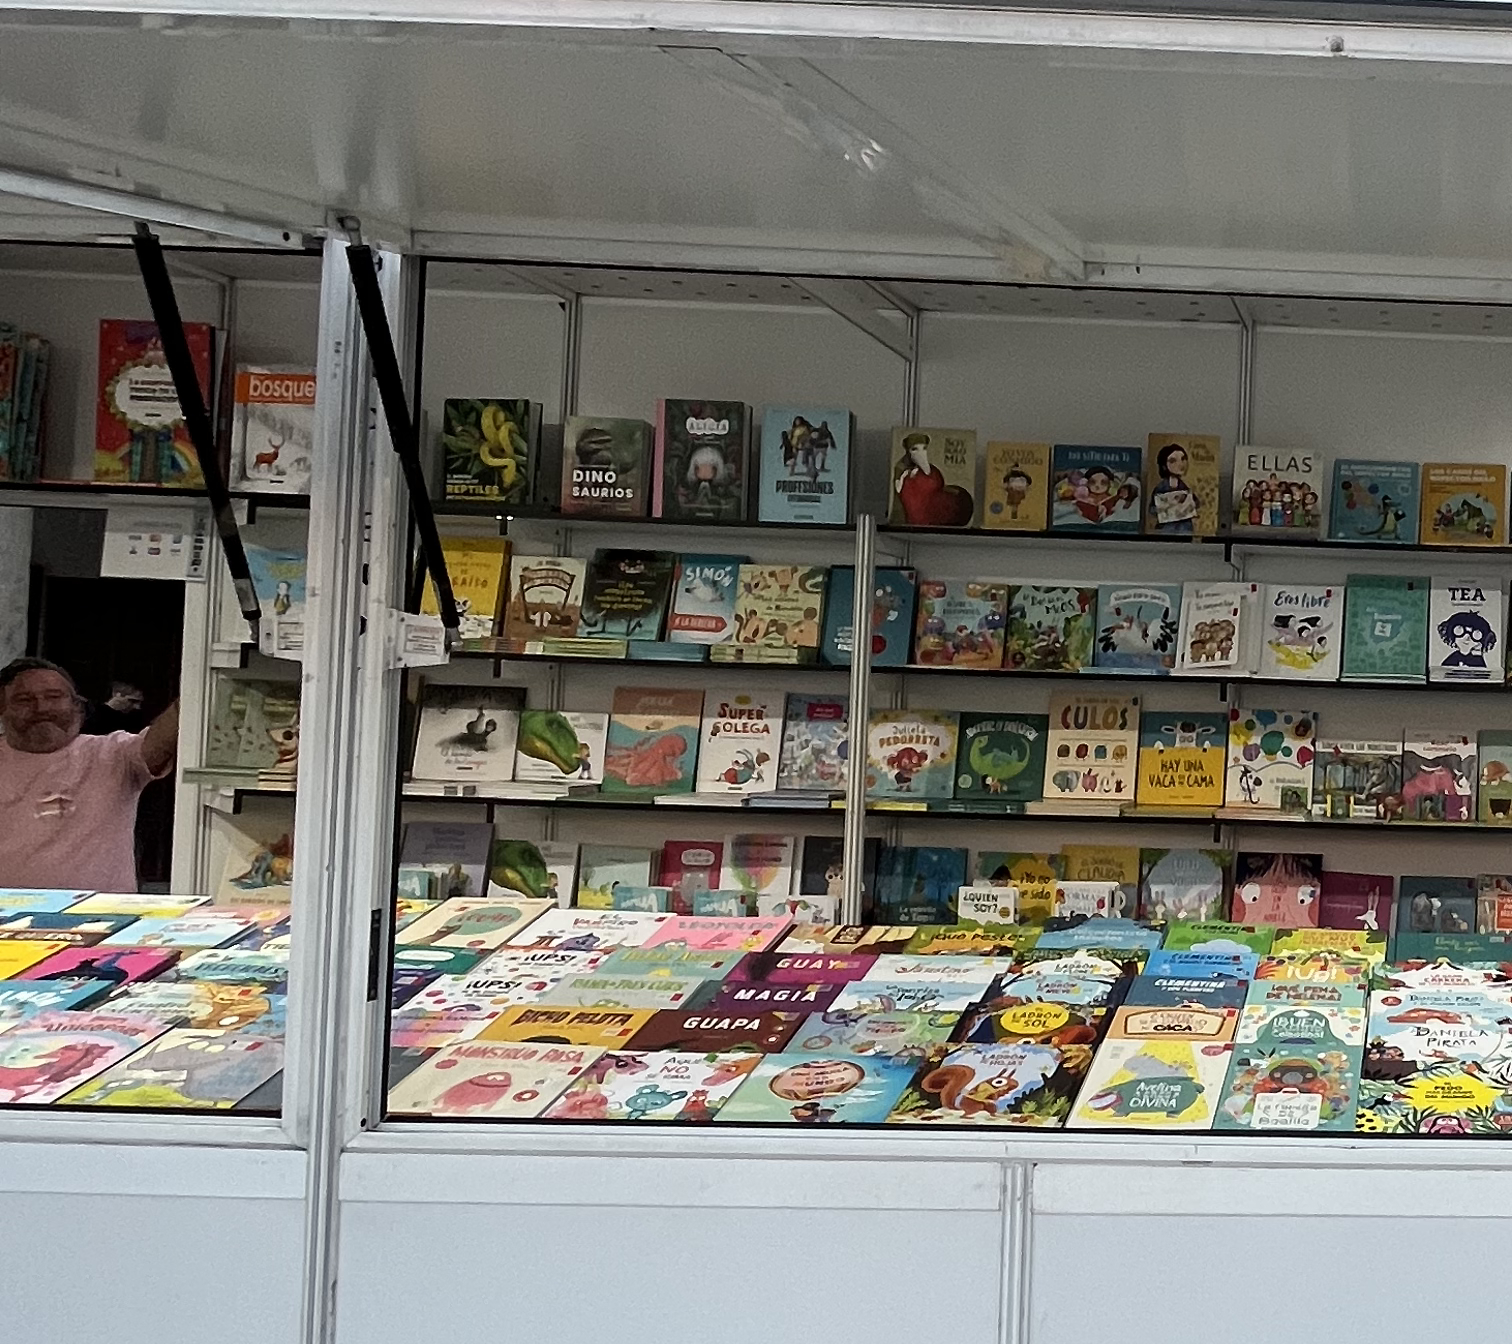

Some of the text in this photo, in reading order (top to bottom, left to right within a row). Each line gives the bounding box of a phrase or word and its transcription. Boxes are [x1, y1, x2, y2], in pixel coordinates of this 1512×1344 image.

[1247, 454, 1313, 474] ELLAS
[573, 469, 617, 484] DINO
[572, 486, 634, 499] SAURIOS
[1448, 587, 1486, 602] TEA
[717, 702, 768, 721] SUPER
[1060, 705, 1129, 731] CULOS
[1160, 758, 1204, 772] HAY UNA
[1148, 773, 1215, 788] VACA CAMA
[776, 958, 838, 970] GUAY
[733, 988, 817, 1002] MAGIA
[1011, 1011, 1063, 1020] LADRÓN
[683, 1016, 761, 1031] GUAPA
[1023, 1019, 1050, 1028] SOL
[1415, 1026, 1489, 1037] DANIELA
[1426, 1037, 1477, 1047] PIRATA
[660, 1065, 690, 1073] NO
[1128, 1097, 1178, 1109] DIVINA
